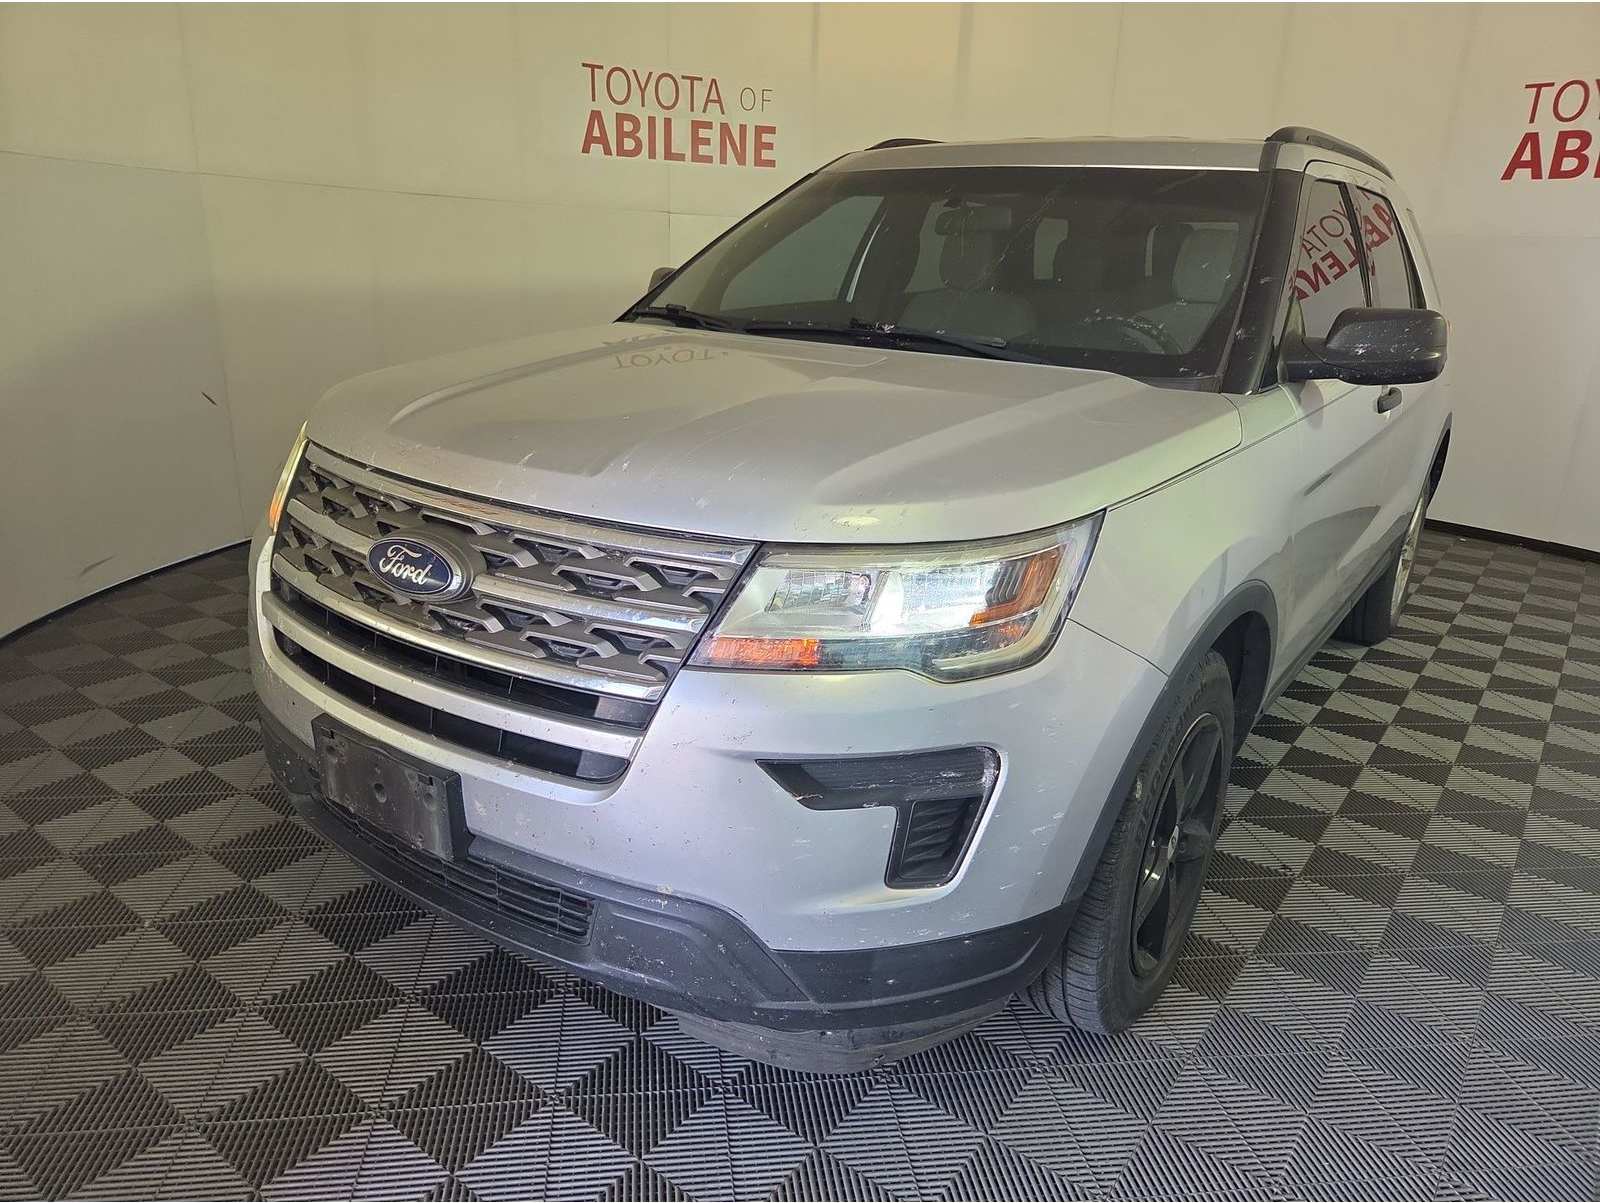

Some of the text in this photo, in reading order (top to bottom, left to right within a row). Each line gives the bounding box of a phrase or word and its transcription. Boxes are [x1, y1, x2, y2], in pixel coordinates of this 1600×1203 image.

[581, 62, 773, 115] TOYOTA OF
[1524, 79, 1600, 124] TO
[581, 109, 777, 168] ABILENE
[379, 544, 433, 585] Ford
